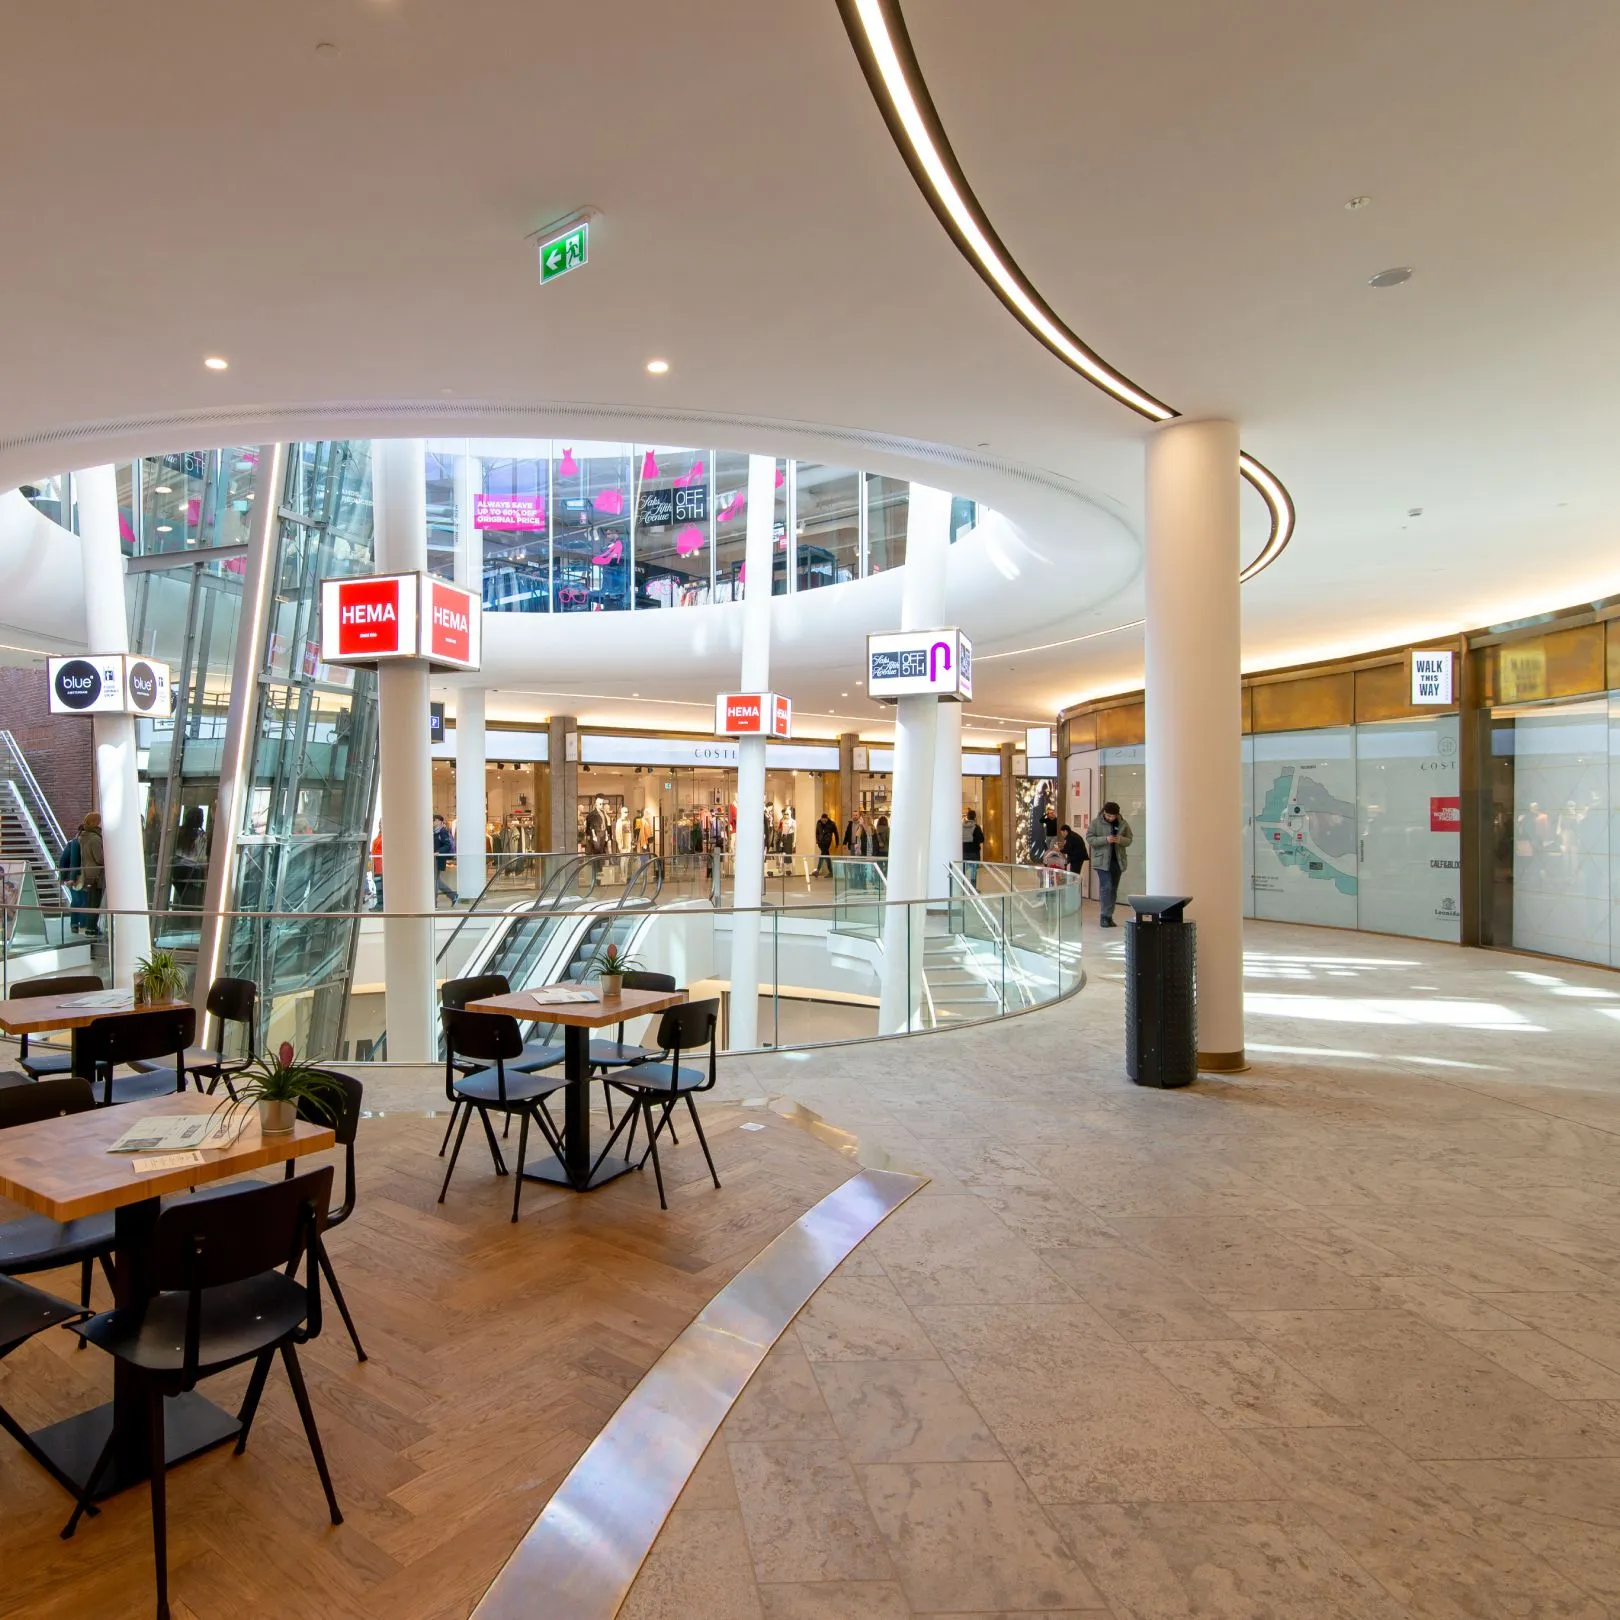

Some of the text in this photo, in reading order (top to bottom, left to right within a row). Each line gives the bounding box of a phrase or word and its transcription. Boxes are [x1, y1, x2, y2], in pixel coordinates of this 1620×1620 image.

[675, 489, 704, 506] OFF
[477, 501, 510, 509] ALWAYS
[676, 503, 704, 520] 5TH
[477, 516, 540, 525] ORIGINAL PRICE
[341, 603, 396, 624] HEMA
[433, 605, 469, 633] HEMA
[901, 652, 925, 665] OFF
[902, 663, 925, 675] 5TH
[1416, 660, 1443, 673] WALK
[63, 675, 92, 688] blue
[133, 676, 153, 691] blue
[1419, 683, 1440, 696] WAY
[727, 706, 760, 718] HEMA
[776, 708, 788, 721] HEMA
